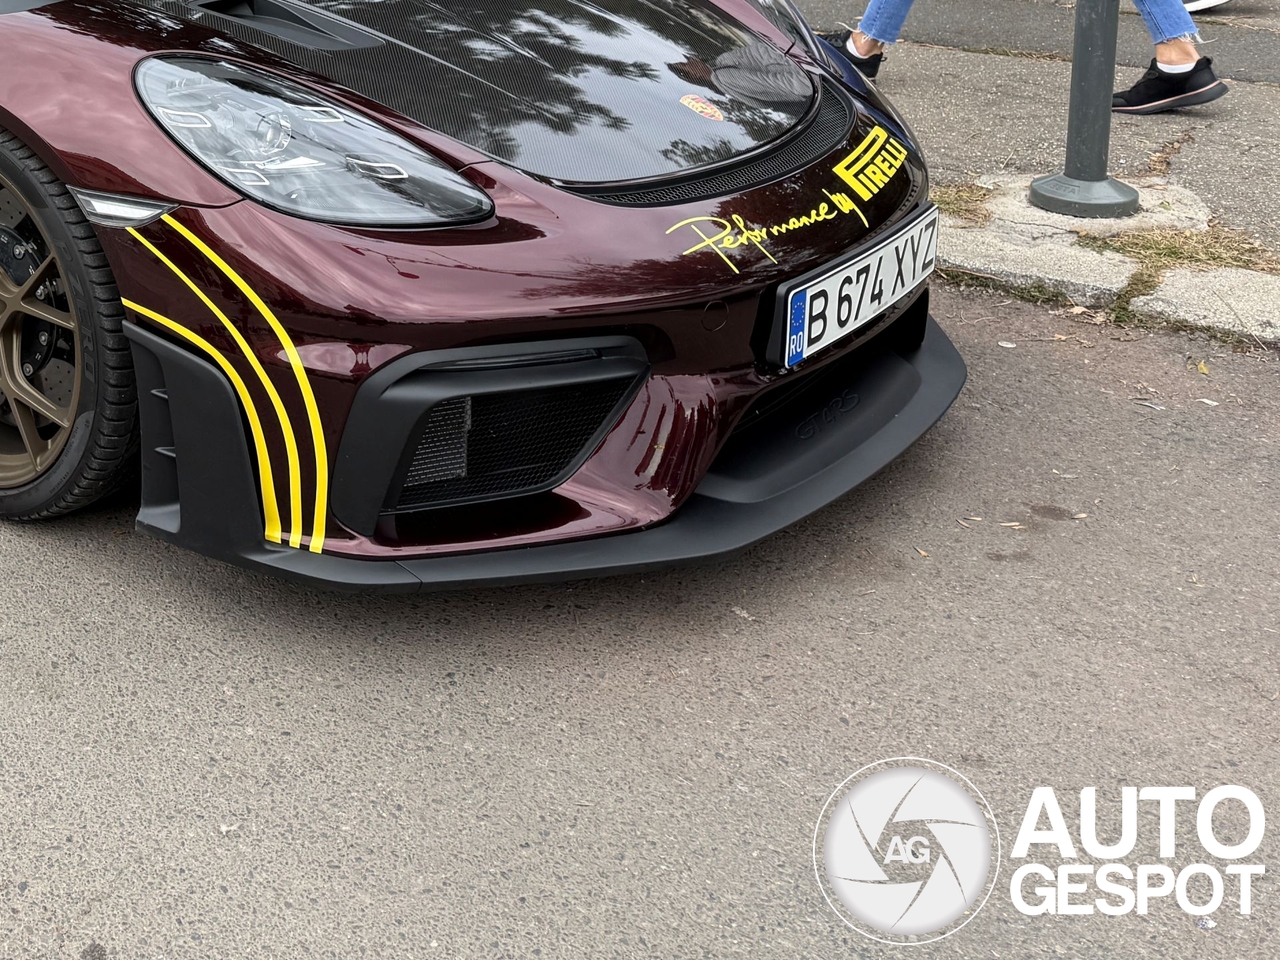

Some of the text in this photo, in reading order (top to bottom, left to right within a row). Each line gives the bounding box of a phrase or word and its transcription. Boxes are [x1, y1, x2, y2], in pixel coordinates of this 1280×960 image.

[666, 125, 908, 274] Performance by PIRELLI
[789, 331, 803, 357] RO
[807, 216, 938, 349] B 674 XYZ
